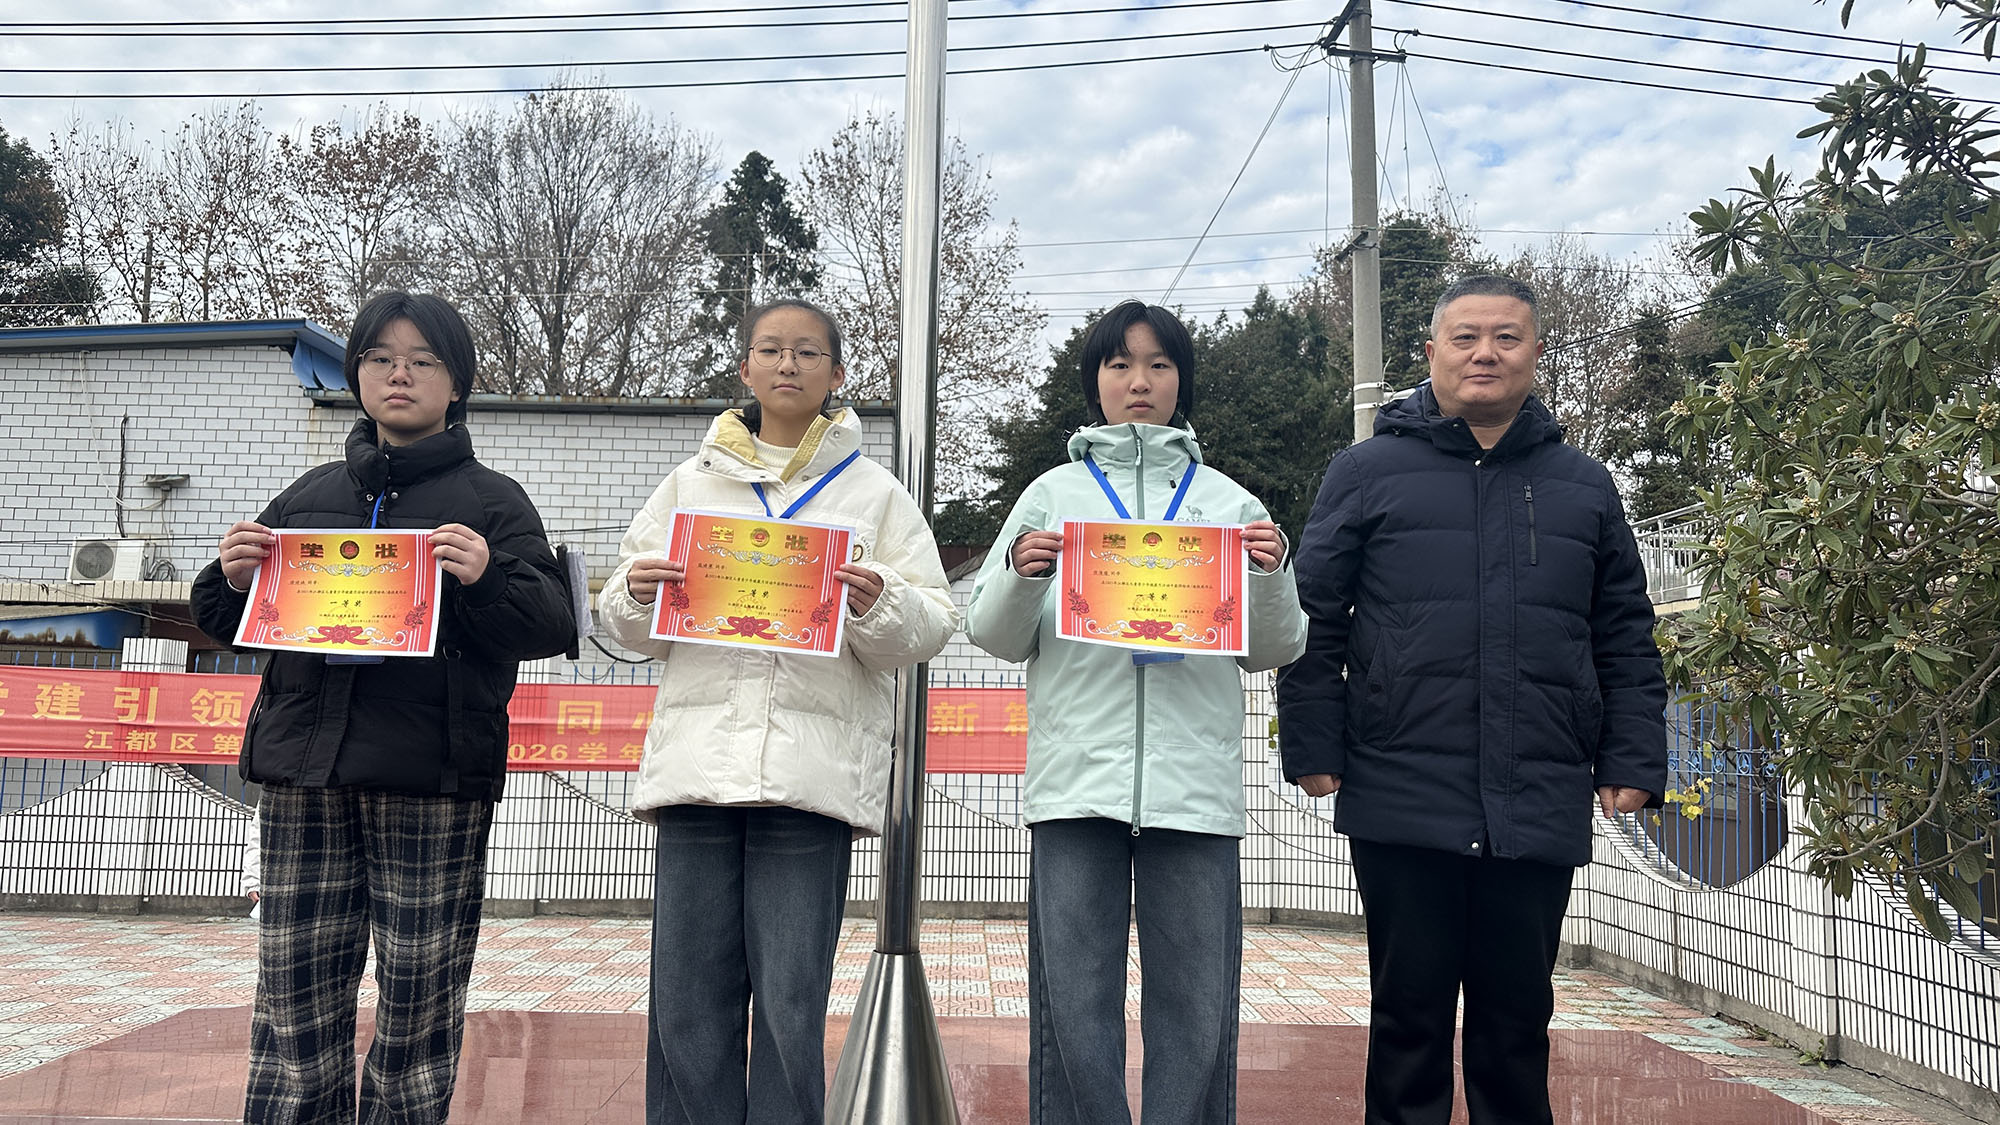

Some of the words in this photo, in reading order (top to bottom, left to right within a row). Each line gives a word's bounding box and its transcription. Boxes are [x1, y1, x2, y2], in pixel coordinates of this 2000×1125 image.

[0, 681, 244, 727] 建引领
[84, 728, 242, 754] 江都区第
